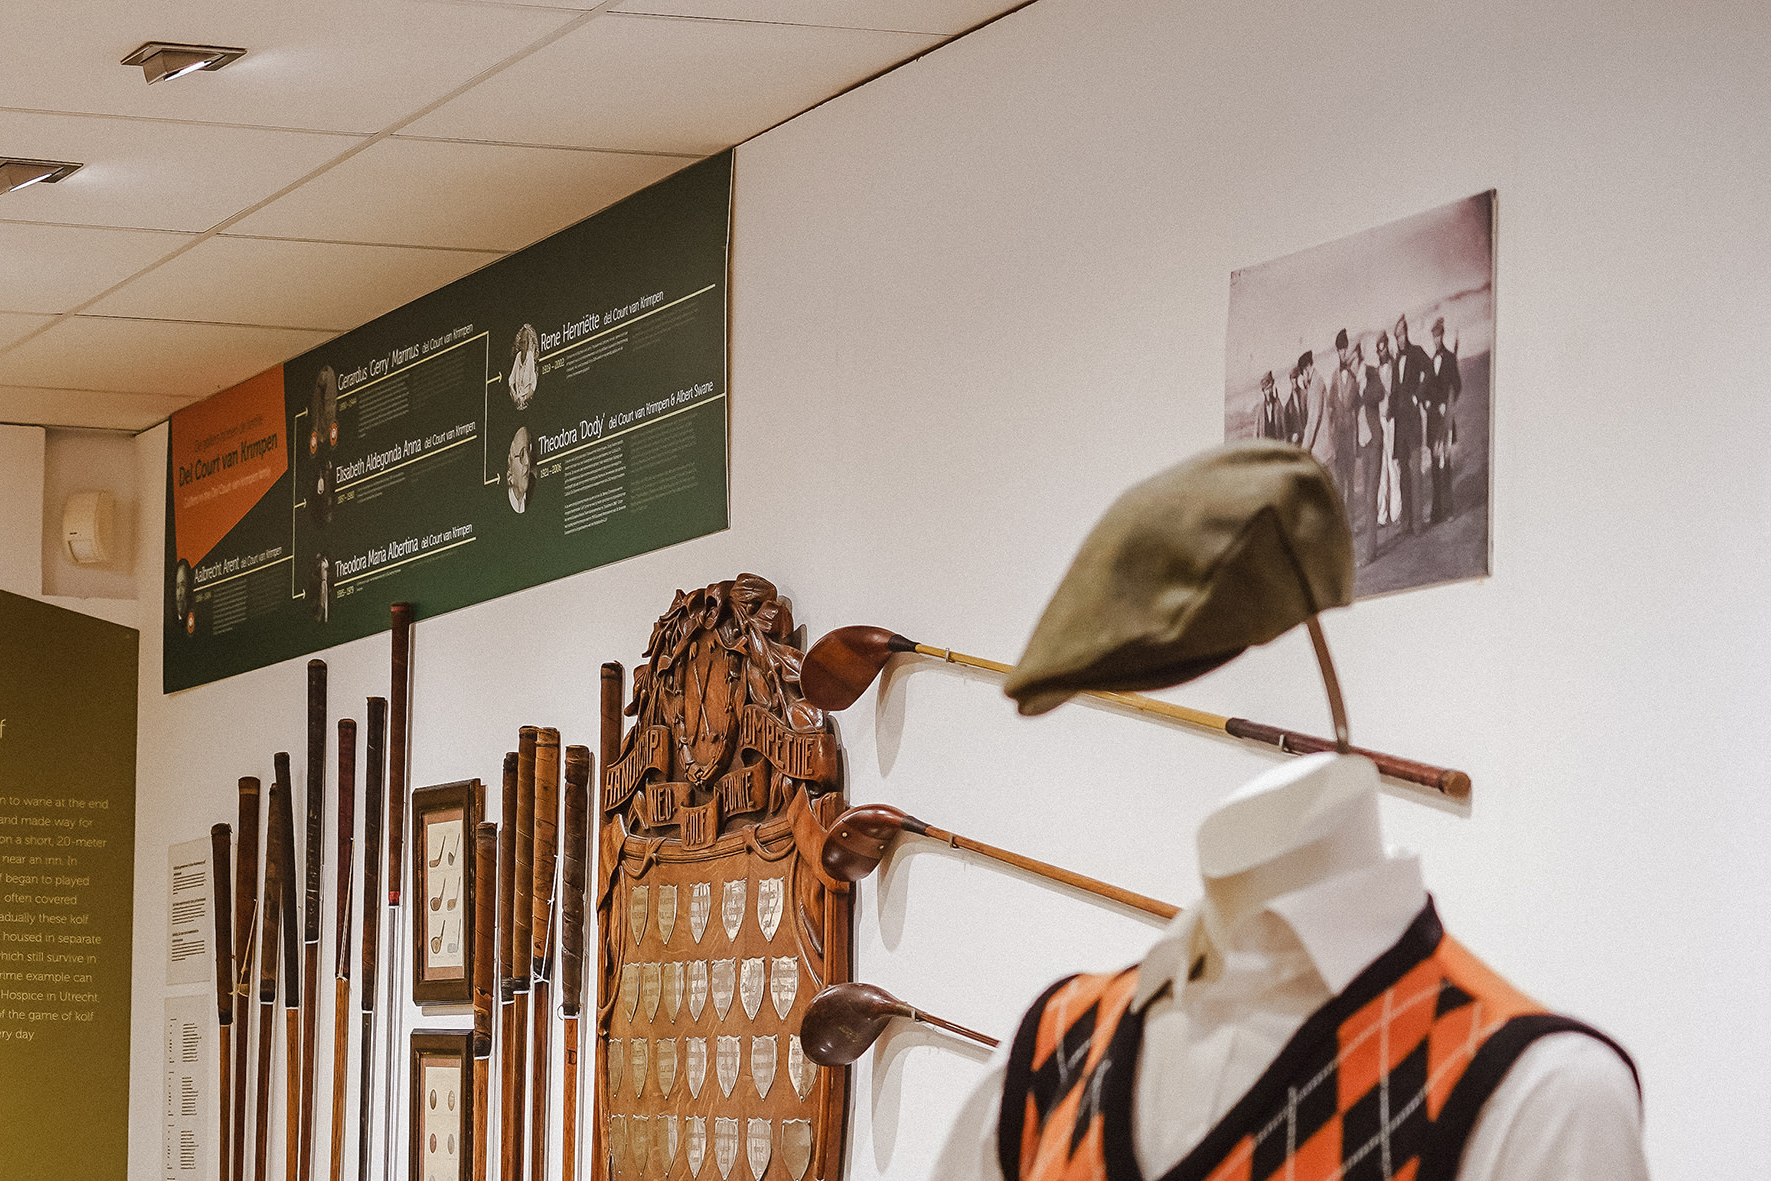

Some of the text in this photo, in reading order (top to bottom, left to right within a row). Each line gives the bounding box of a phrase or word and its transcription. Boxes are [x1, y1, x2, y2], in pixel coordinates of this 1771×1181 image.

[603, 311, 612, 326] del
[613, 305, 628, 321] Court
[629, 301, 640, 314] van
[538, 428, 578, 455] Theodora
[608, 416, 617, 430] del
[618, 409, 634, 426] Court
[635, 406, 646, 419] van
[403, 438, 422, 457] Anna
[432, 432, 445, 446] Court
[179, 463, 193, 487] Del
[195, 457, 220, 480] Court
[222, 450, 238, 470] van
[335, 555, 367, 578] Theodora
[367, 546, 387, 567] Maria
[429, 532, 443, 547] Court
[20, 817, 52, 826] made
[54, 819, 76, 829] way
[78, 819, 92, 827] for
[6, 874, 38, 886] began
[42, 876, 52, 884] to
[56, 875, 90, 887] played
[2, 932, 42, 942] housed
[46, 933, 54, 942] in
[58, 935, 102, 944] separate
